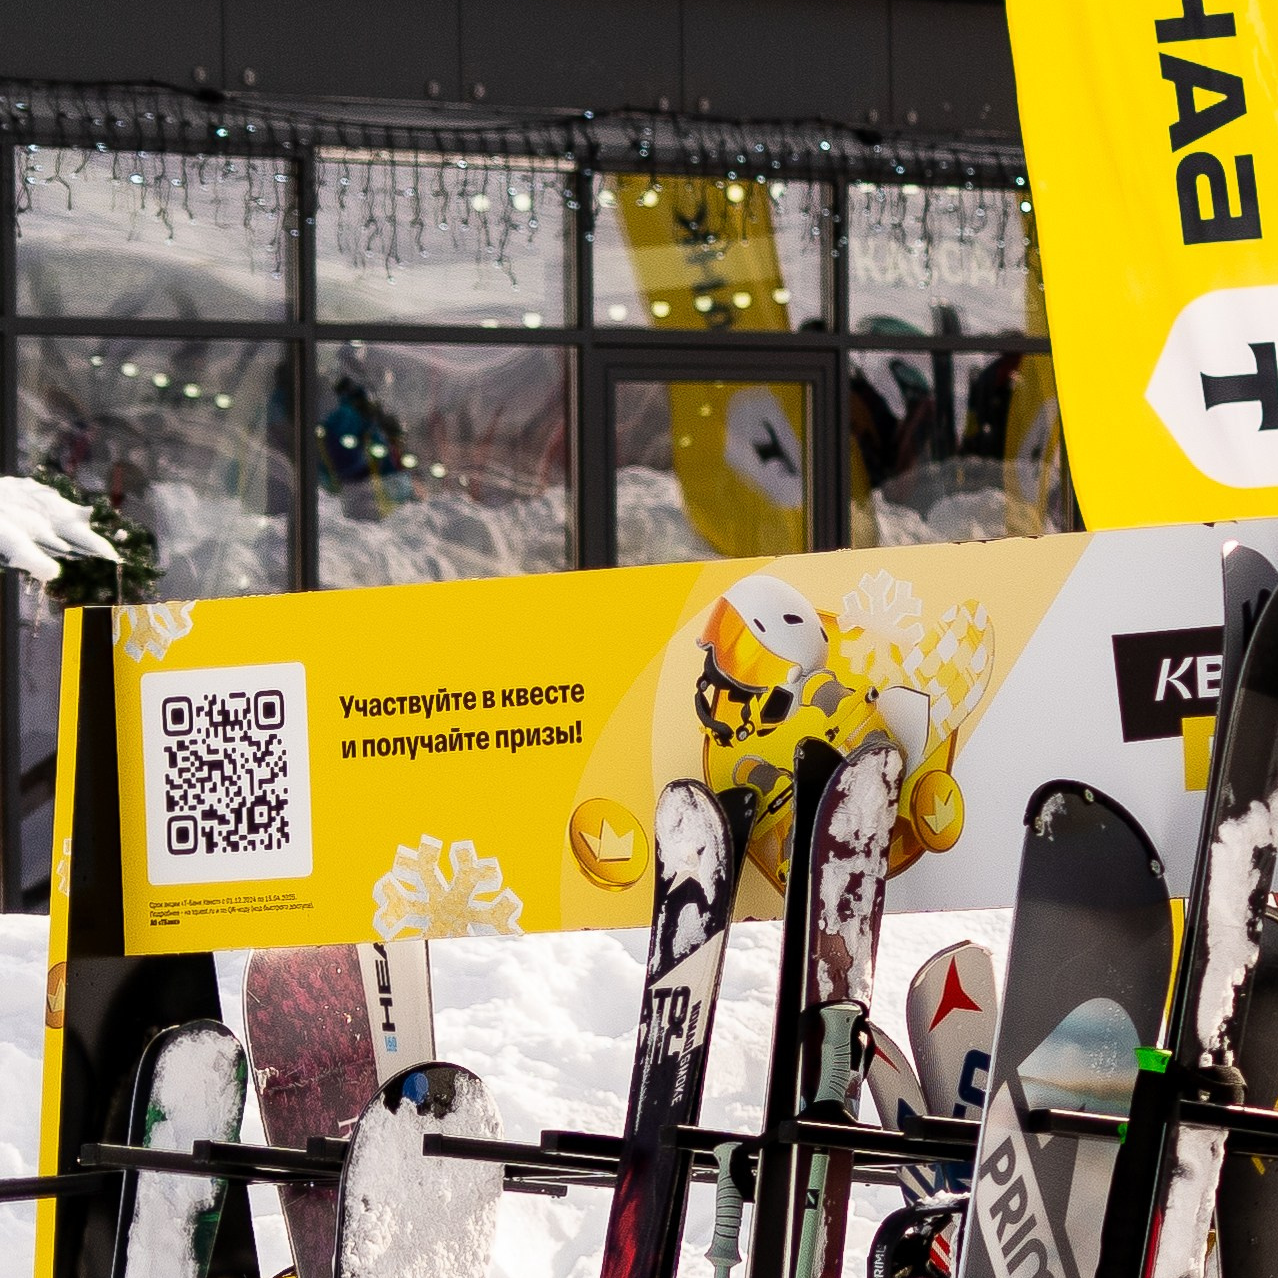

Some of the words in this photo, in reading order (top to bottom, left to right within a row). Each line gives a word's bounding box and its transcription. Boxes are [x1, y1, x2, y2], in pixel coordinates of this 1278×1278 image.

[339, 687, 476, 720] Участвуйте
[482, 689, 496, 709] в
[501, 683, 585, 708] квесте
[341, 740, 356, 759] и
[362, 728, 489, 760] получайте
[495, 720, 583, 754] призы!
